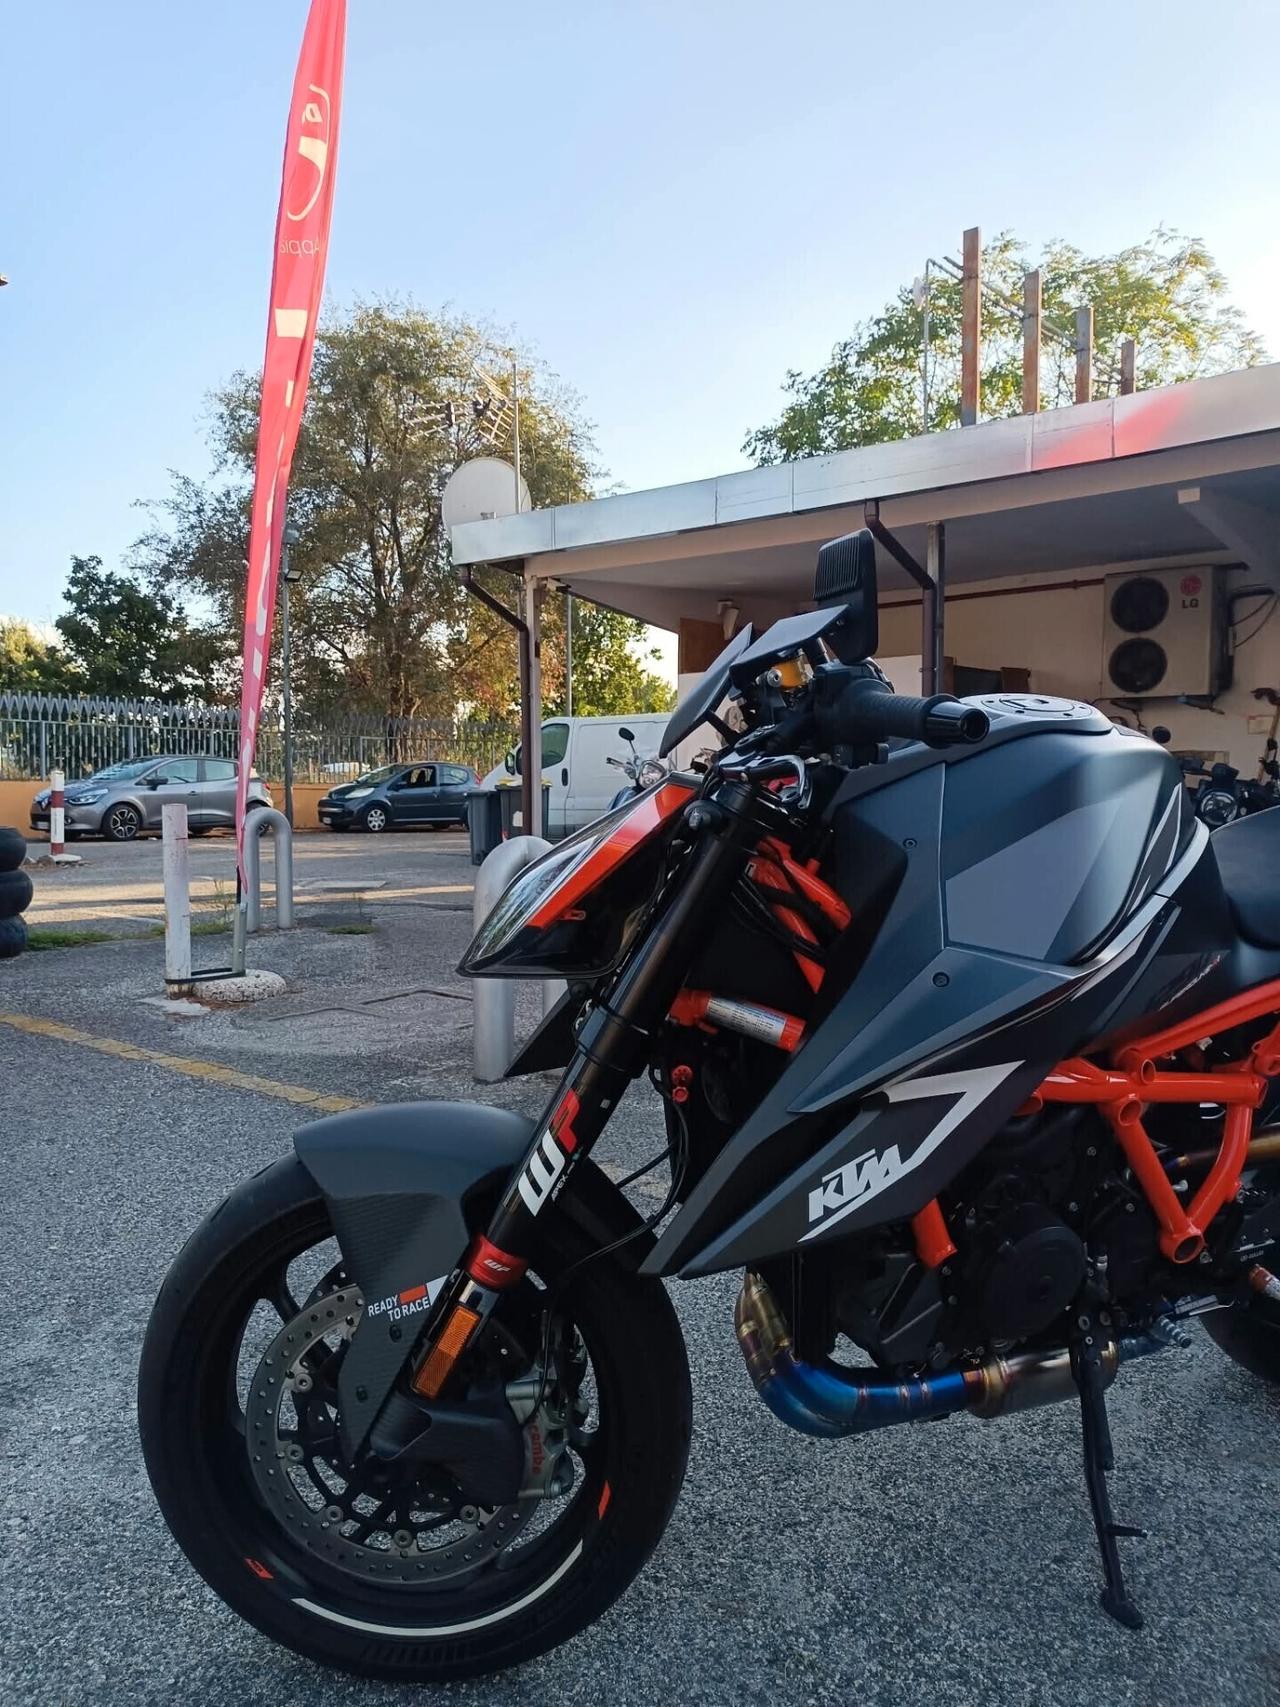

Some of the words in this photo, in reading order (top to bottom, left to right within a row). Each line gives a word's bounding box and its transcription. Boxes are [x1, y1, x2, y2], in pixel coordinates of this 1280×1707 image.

[1182, 598, 1199, 609] LG
[808, 1143, 906, 1223] KTM
[367, 1295, 399, 1317] READY
[387, 1304, 402, 1322] TO
[401, 1296, 430, 1317] RACE
